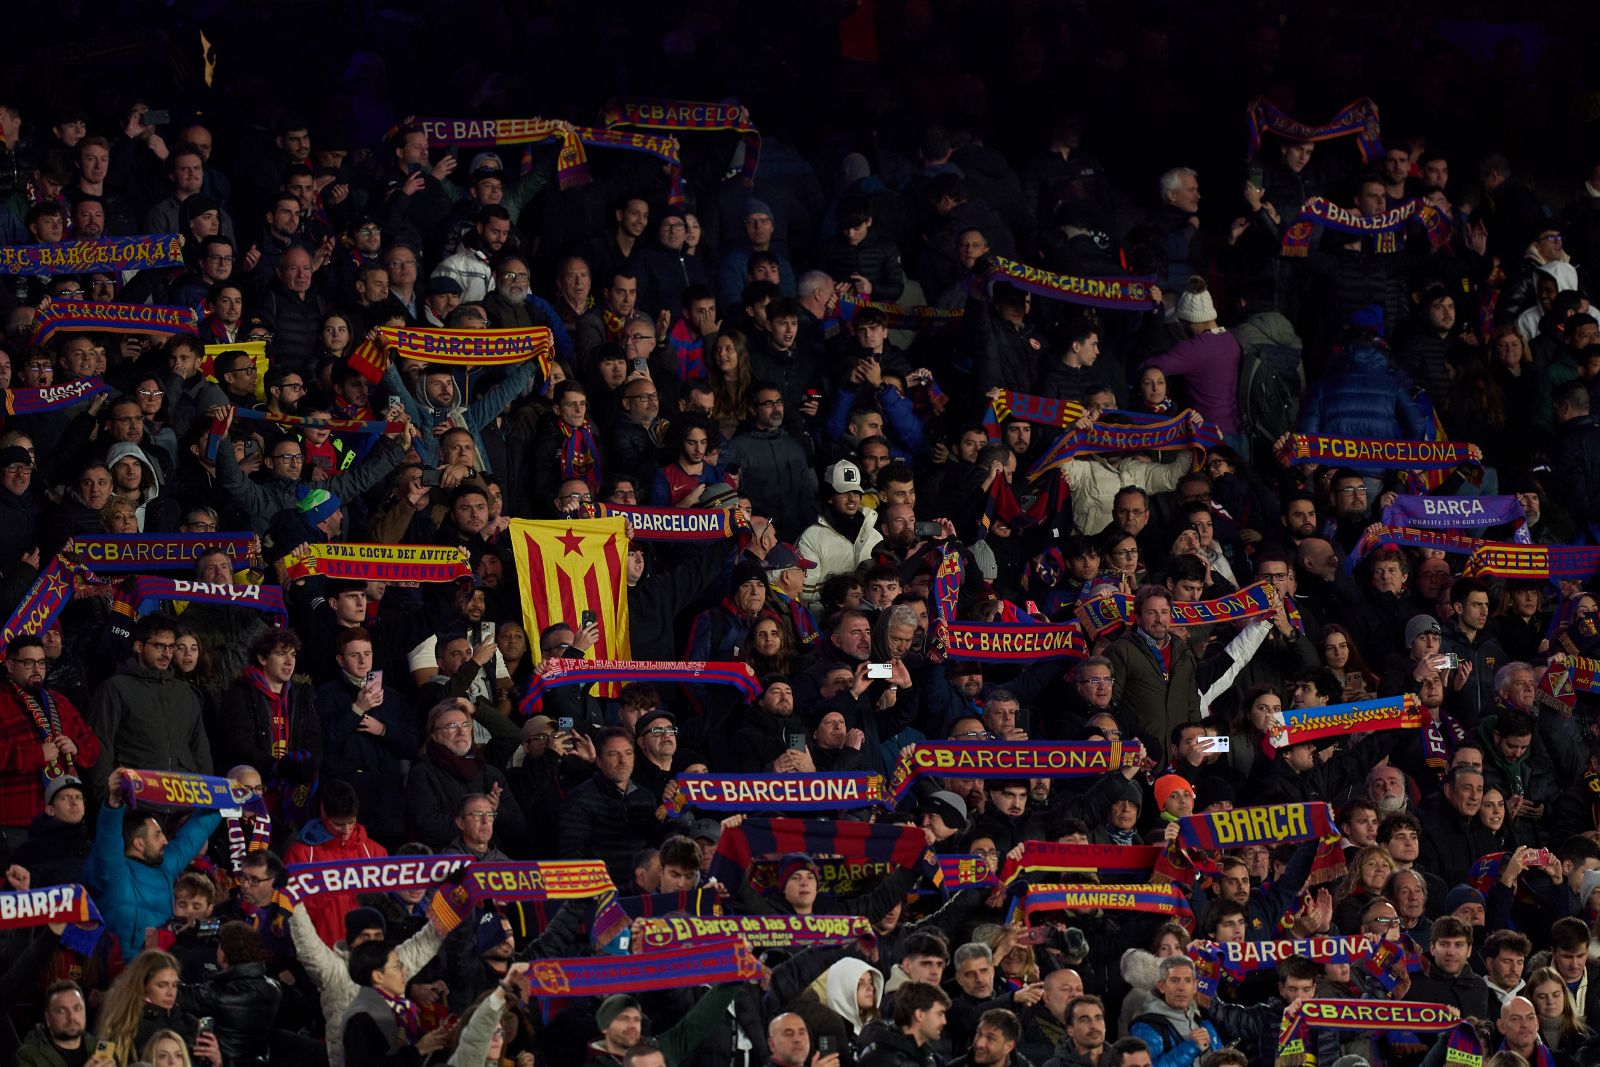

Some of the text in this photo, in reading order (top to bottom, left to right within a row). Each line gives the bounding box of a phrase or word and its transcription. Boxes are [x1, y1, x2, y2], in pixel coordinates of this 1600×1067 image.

[422, 122, 447, 140] FC
[39, 243, 166, 266] BARCELONA
[68, 303, 181, 325] BARCELONA
[397, 331, 534, 356] FC BARCELONA
[1318, 437, 1457, 462] FCBARCELONA
[1424, 499, 1485, 518] BARÇA
[632, 513, 719, 531] BARCELONA
[953, 631, 974, 650] FC
[980, 632, 1074, 653] BARCELONA
[161, 777, 213, 805] SOSES
[687, 779, 859, 802] FC BARCELONA
[1213, 803, 1307, 847] BARÇA
[286, 873, 320, 900] FC
[0, 887, 75, 920] BARÇA
[1065, 893, 1136, 908] MANRESA
[671, 916, 849, 941] El Barça de las 6 Copas
[1226, 936, 1374, 963] BARCELONA
